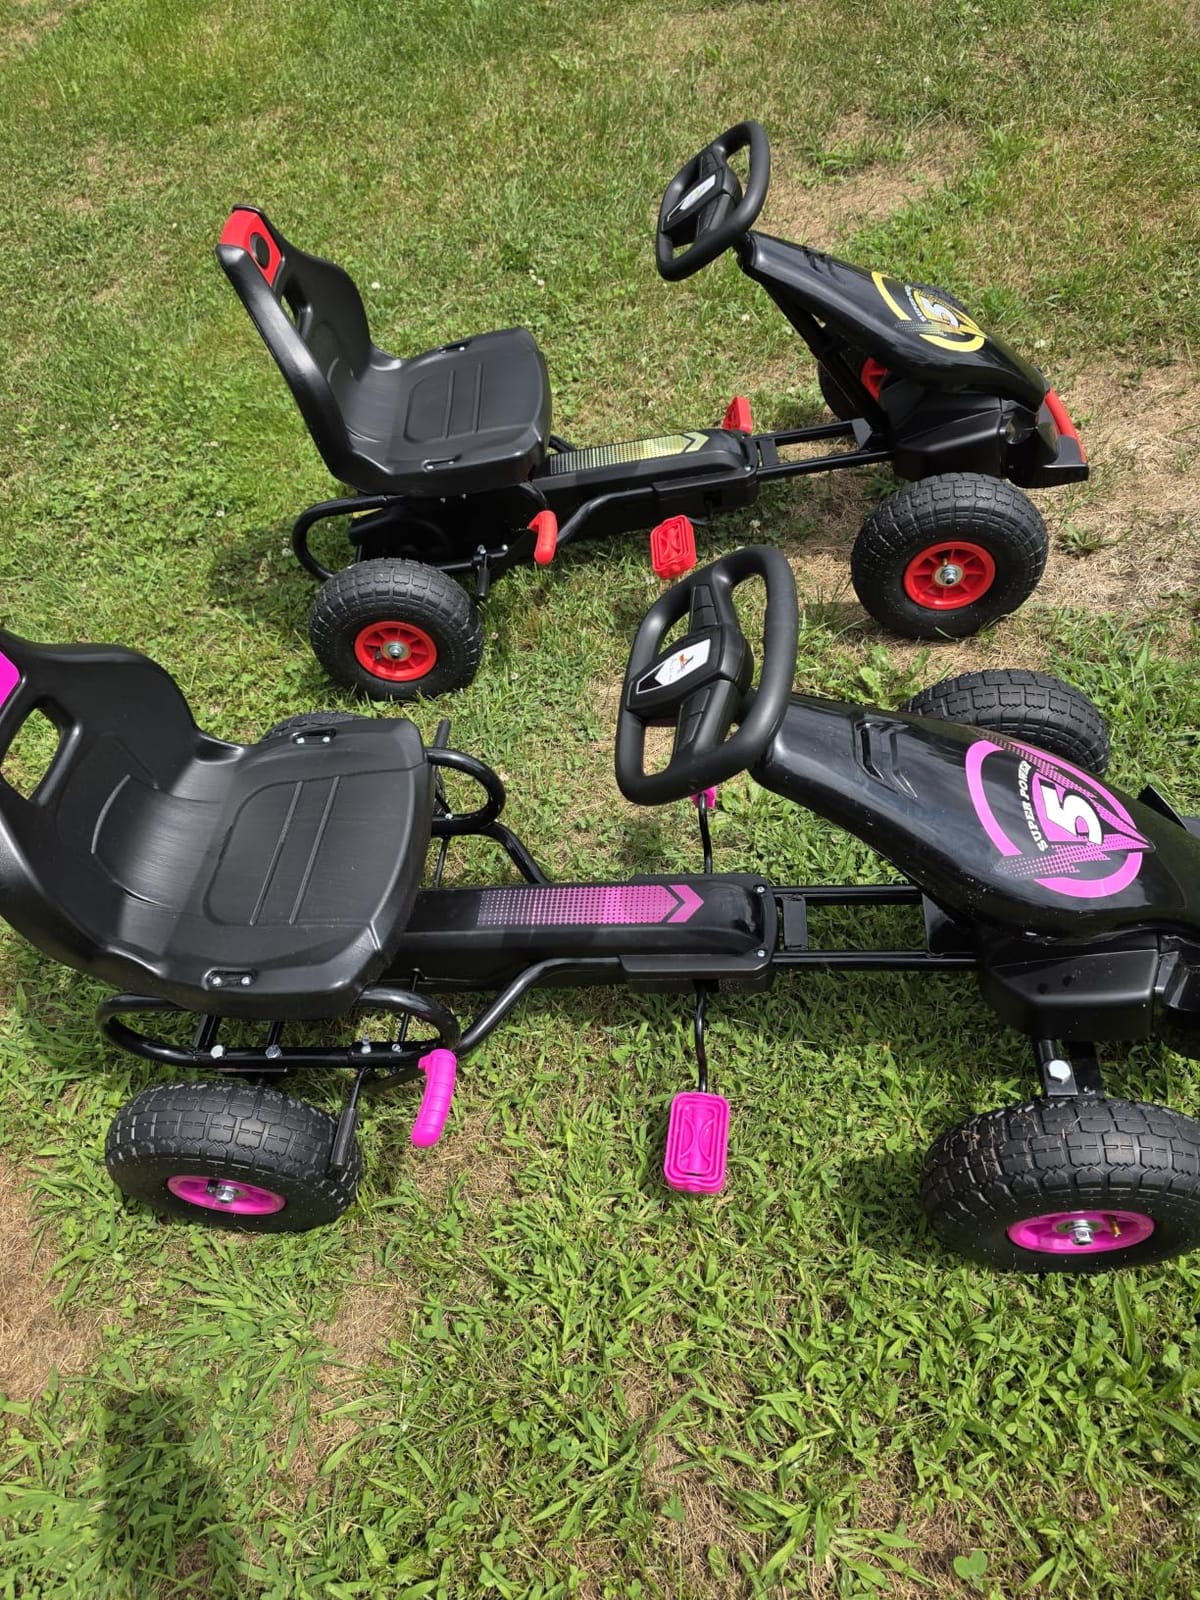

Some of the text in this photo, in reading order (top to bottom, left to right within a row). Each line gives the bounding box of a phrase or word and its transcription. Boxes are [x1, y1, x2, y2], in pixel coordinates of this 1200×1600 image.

[919, 295, 959, 328] 5
[1018, 760, 1048, 852] SUPER POWER
[1040, 784, 1103, 846] 5
